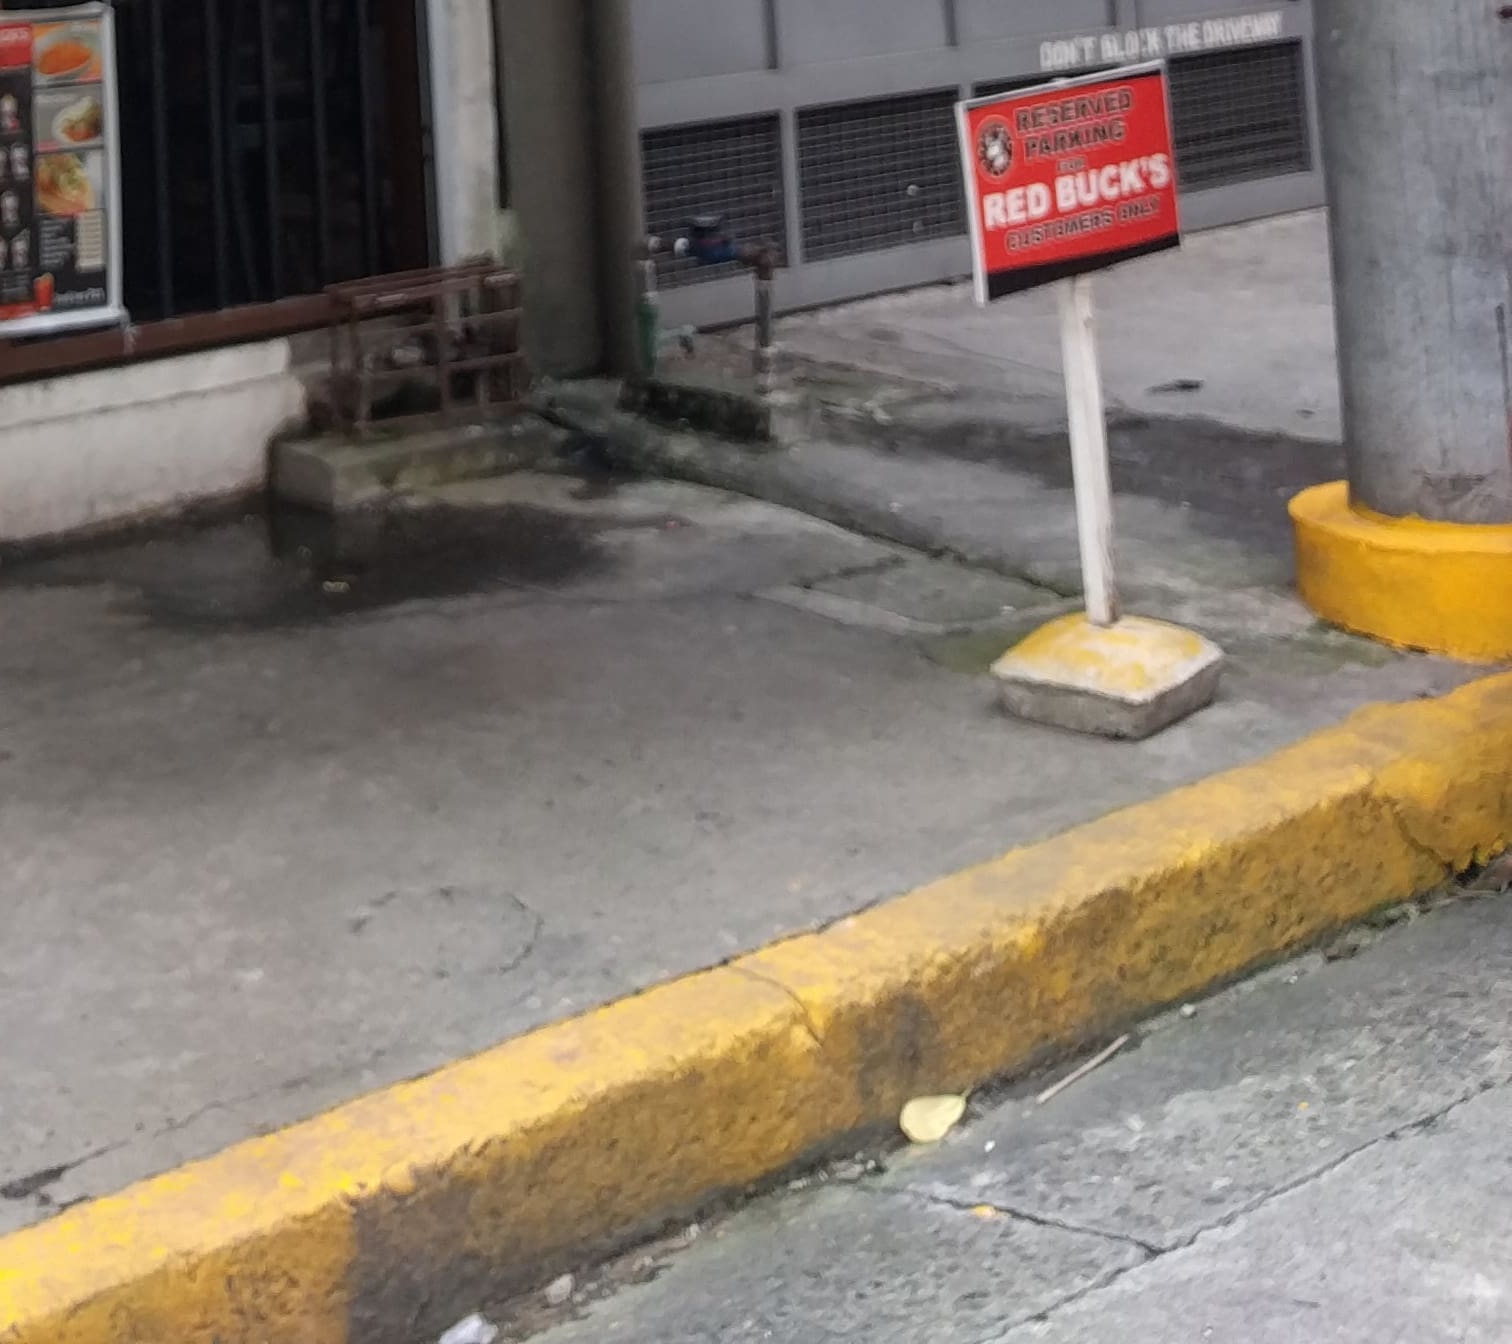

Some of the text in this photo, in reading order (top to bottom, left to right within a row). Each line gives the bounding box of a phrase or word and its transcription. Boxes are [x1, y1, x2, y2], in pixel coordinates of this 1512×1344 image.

[1101, 26, 1162, 62] BLOCK
[1163, 21, 1201, 54] THE
[1015, 87, 1134, 133] RESERVED
[1024, 117, 1128, 160] PARKING
[983, 153, 1172, 231] RED BUCK'S
[1005, 195, 1162, 251] CUSTOMERS ONLY
